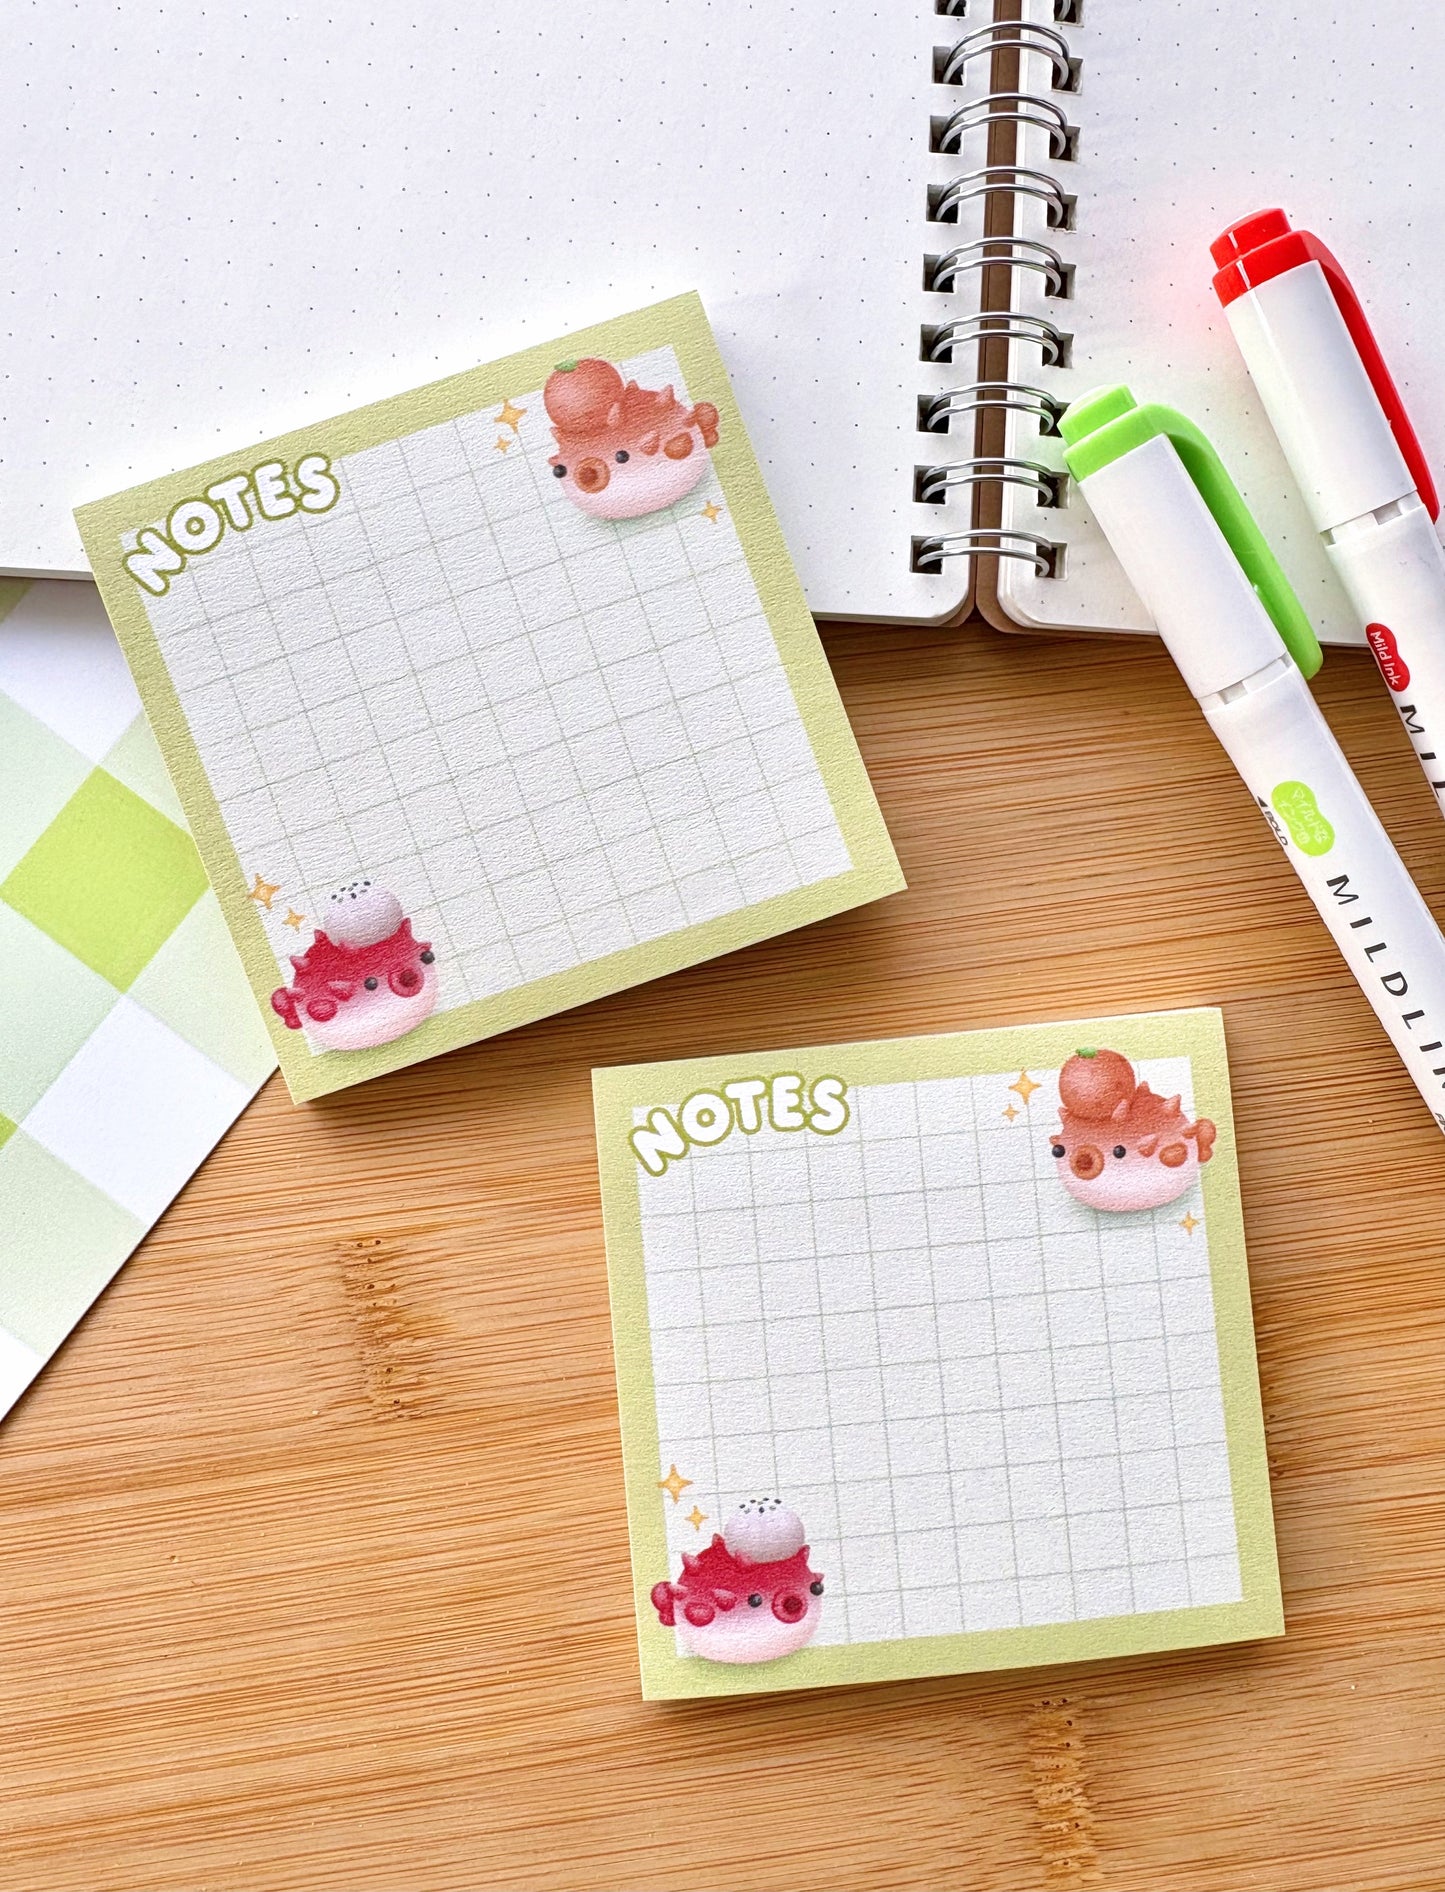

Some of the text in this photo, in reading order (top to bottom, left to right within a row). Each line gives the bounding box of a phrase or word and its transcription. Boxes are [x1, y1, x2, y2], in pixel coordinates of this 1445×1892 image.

[122, 452, 340, 597] NOTES
[1370, 630, 1402, 686] Mild Ink
[1264, 810, 1288, 846] BOLD
[628, 1070, 850, 1177] NOTES
